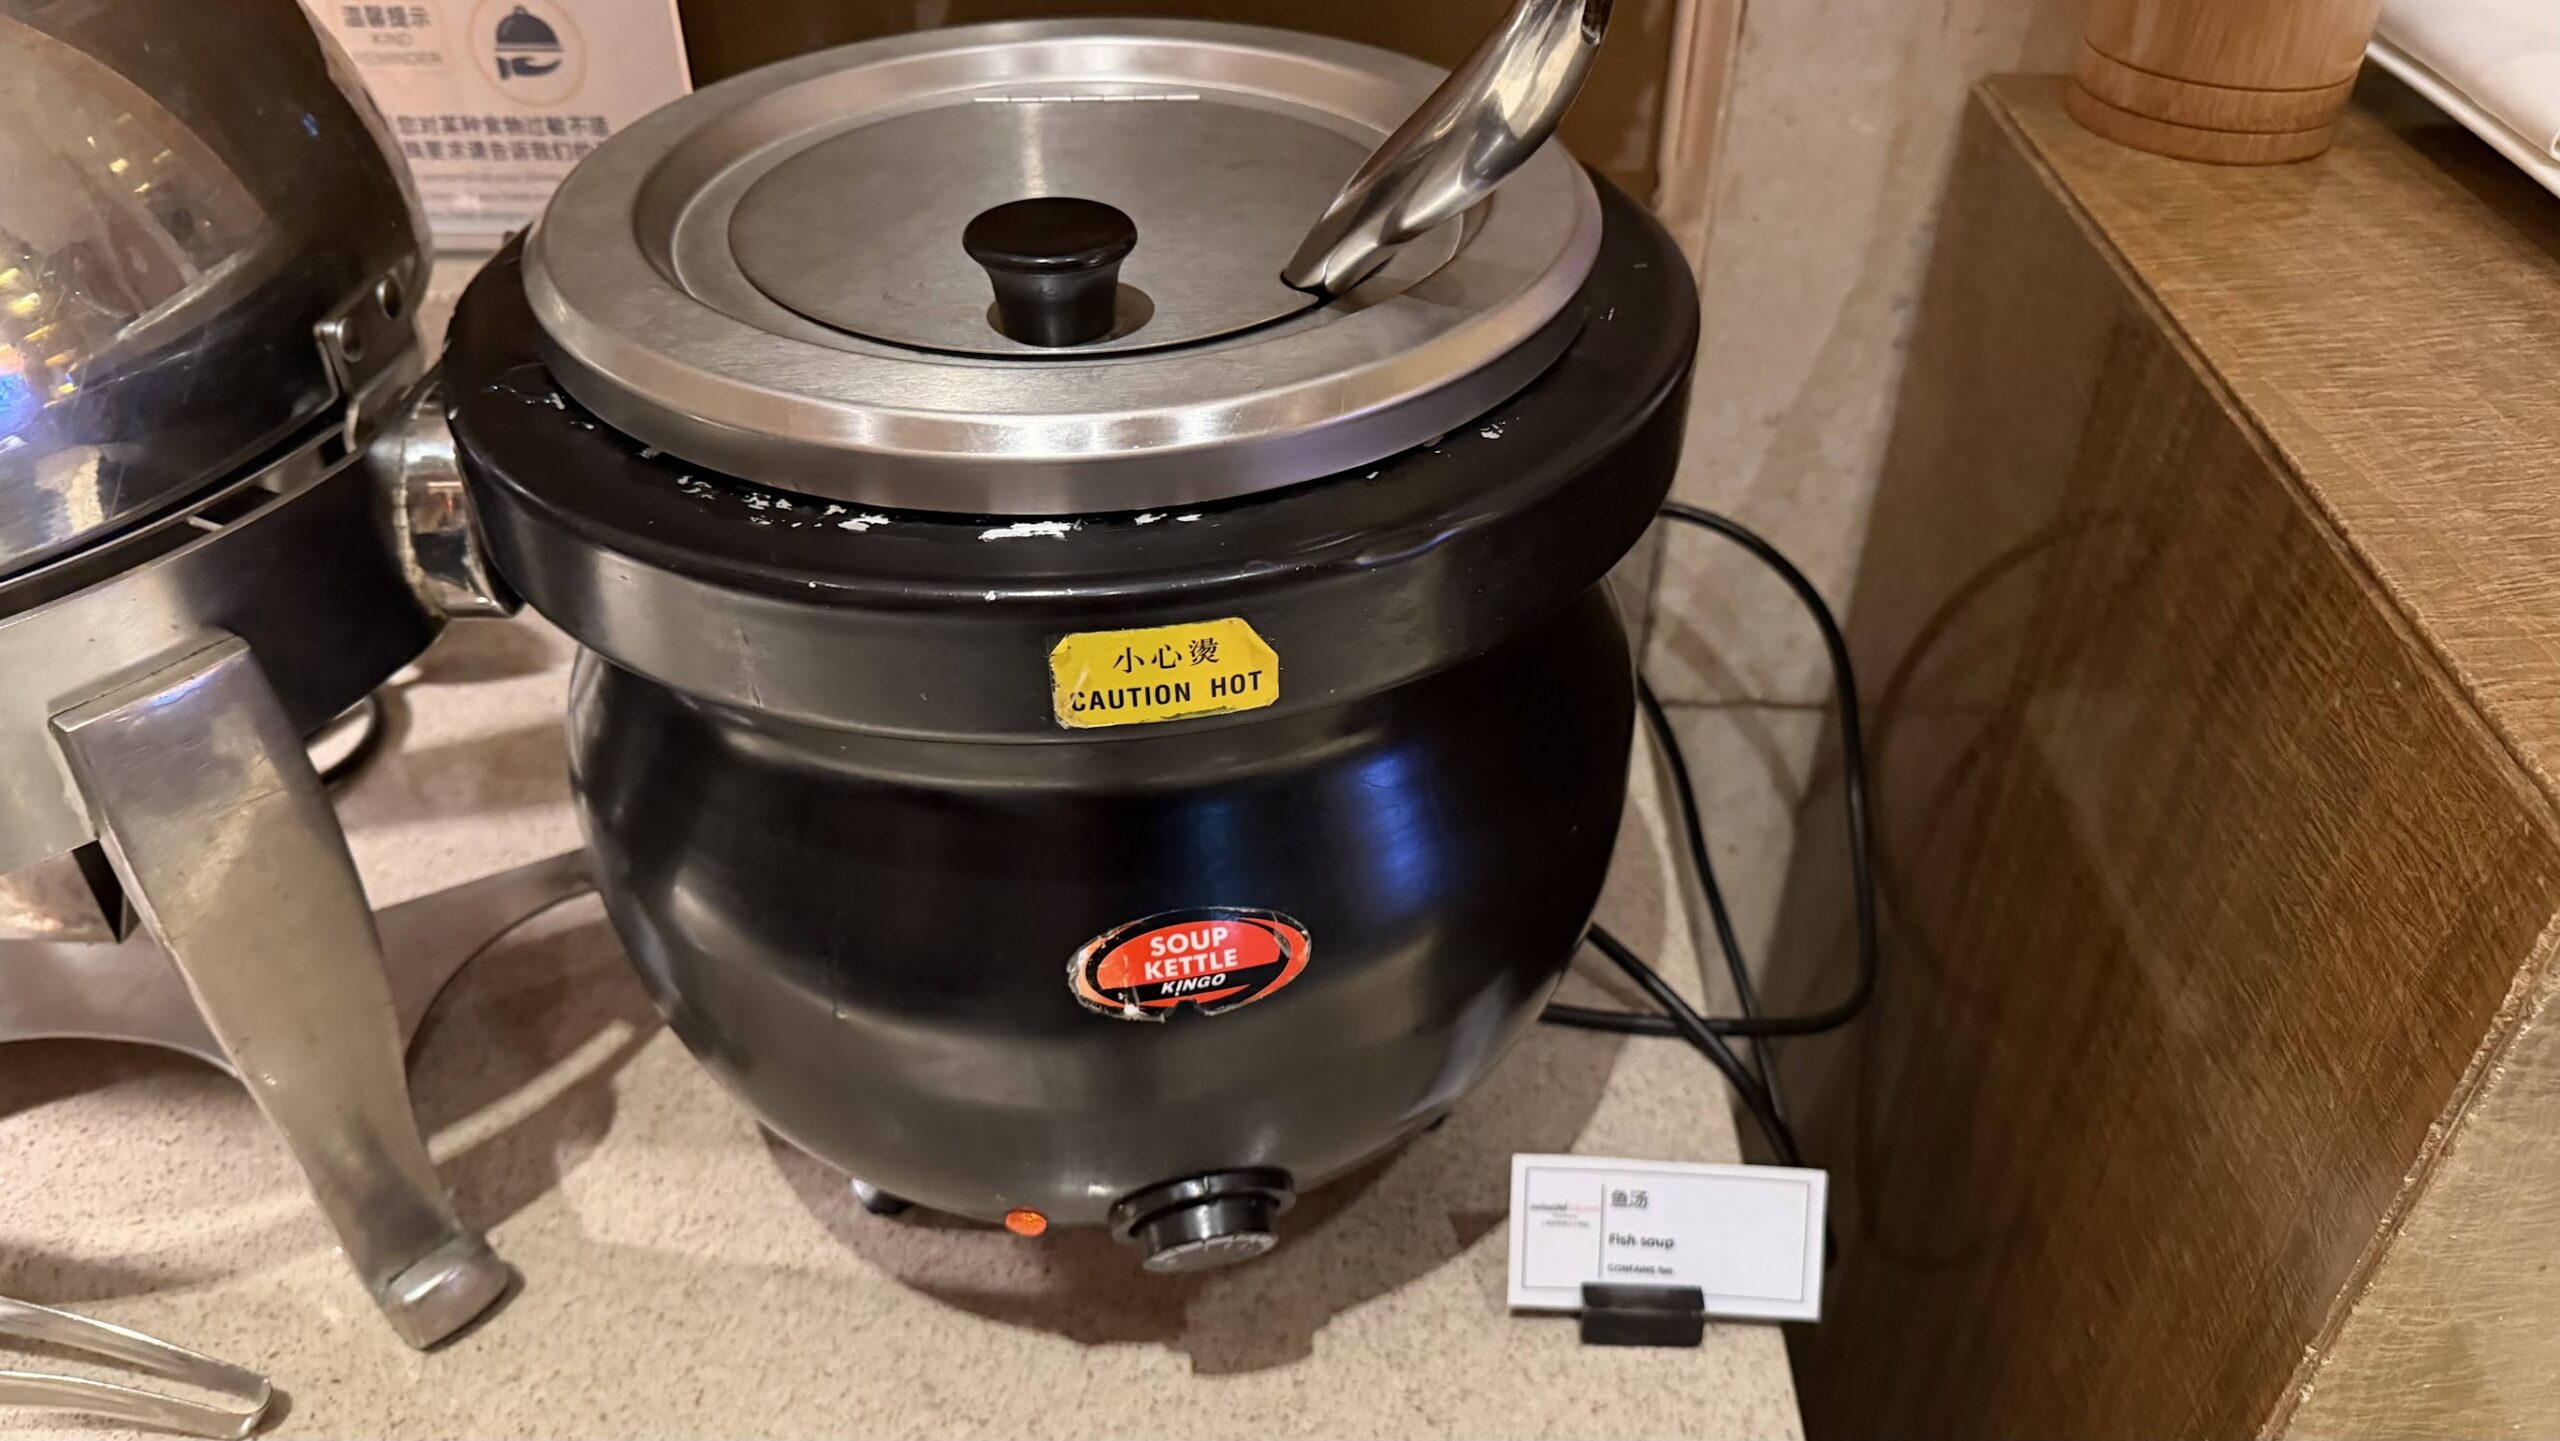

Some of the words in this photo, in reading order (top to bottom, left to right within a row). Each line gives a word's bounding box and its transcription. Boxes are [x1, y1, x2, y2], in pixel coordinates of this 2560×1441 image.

[342, 5, 432, 28] 温馨提示
[371, 32, 414, 47] KIND
[387, 114, 610, 137] 您对某种食物过敏不适
[1113, 638, 1219, 673] 小心燙
[1071, 682, 1191, 712] CAUTION
[1211, 670, 1263, 698] HOT
[1150, 926, 1229, 957] SOUP
[1144, 948, 1239, 981] KETTLE
[1610, 1189, 1648, 1209] 鱼汤
[1640, 1236, 1675, 1250] soup
